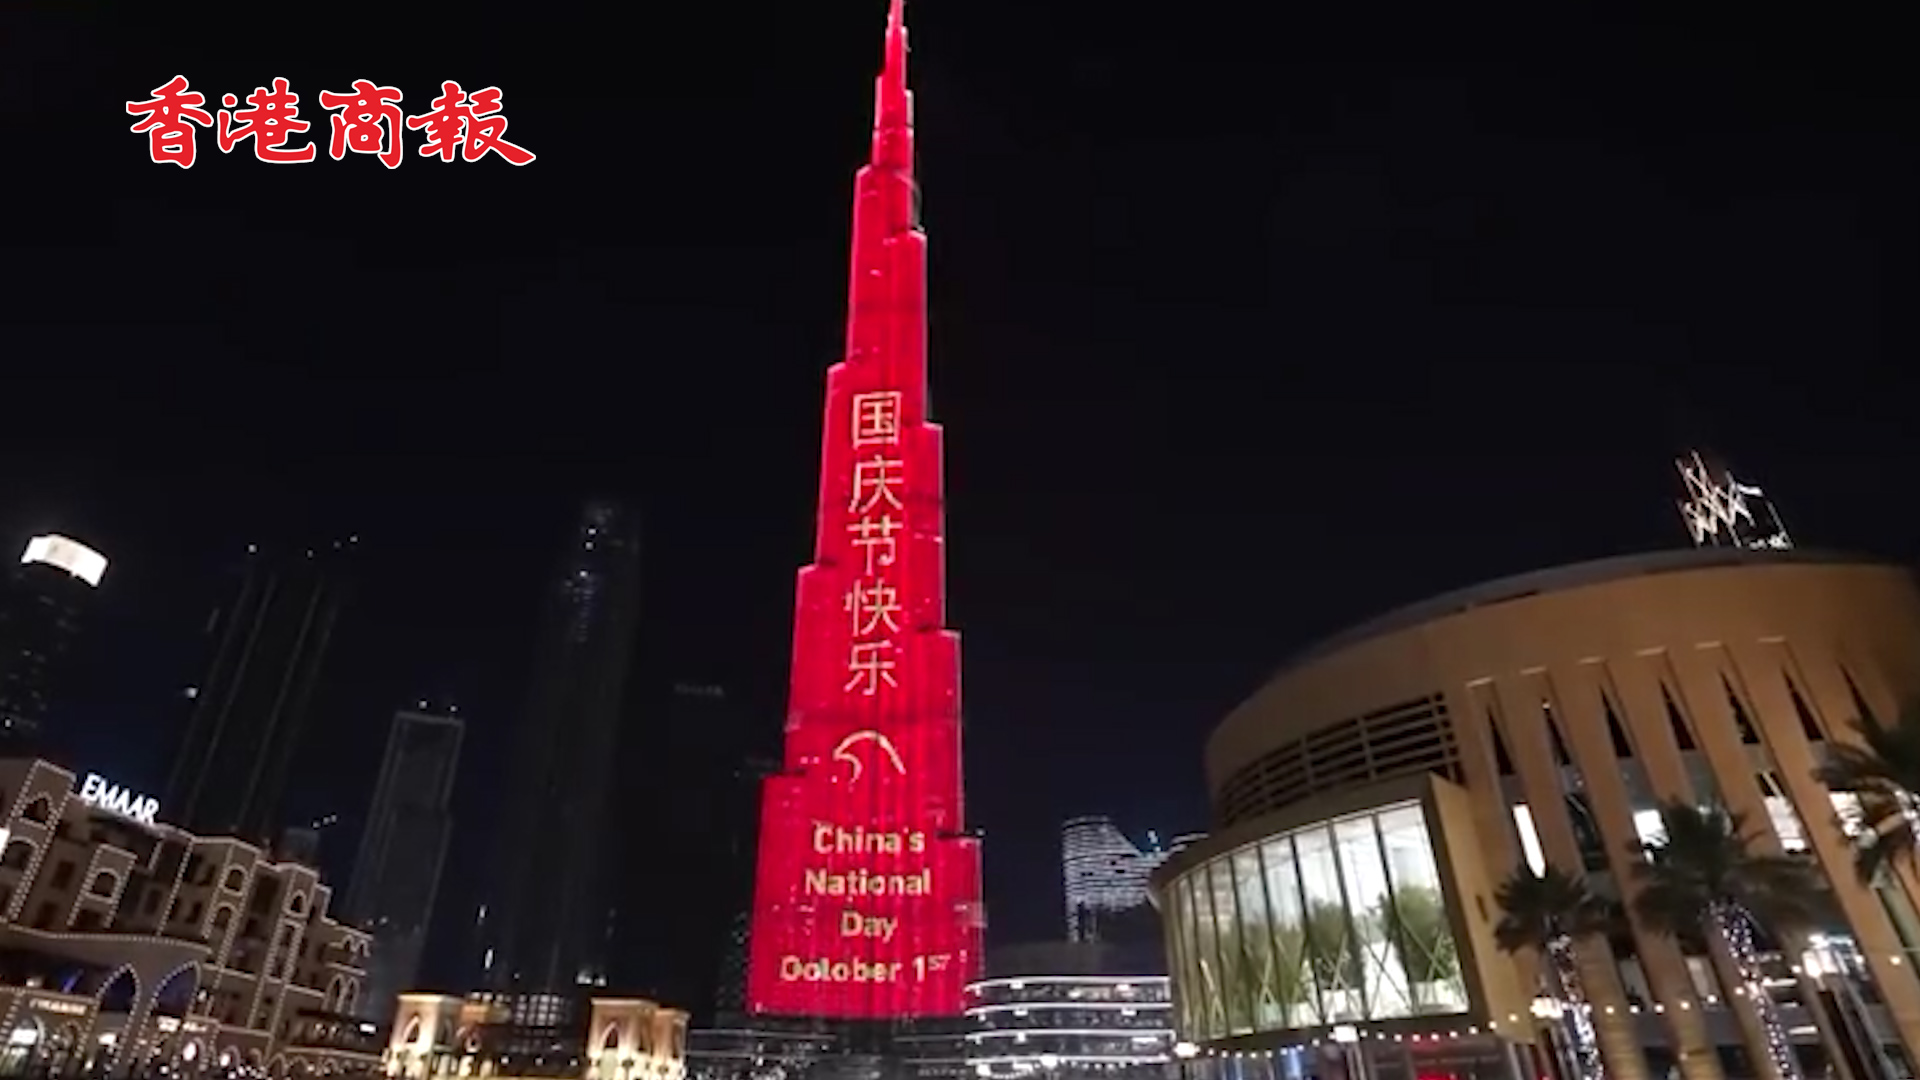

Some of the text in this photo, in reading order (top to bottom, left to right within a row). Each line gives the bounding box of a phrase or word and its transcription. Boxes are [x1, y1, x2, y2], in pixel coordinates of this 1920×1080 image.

[843, 391, 903, 696] 国庆节快乐
[80, 773, 159, 827] EMAAR
[813, 825, 925, 854] China's
[805, 868, 932, 896] National
[840, 911, 898, 944] Day
